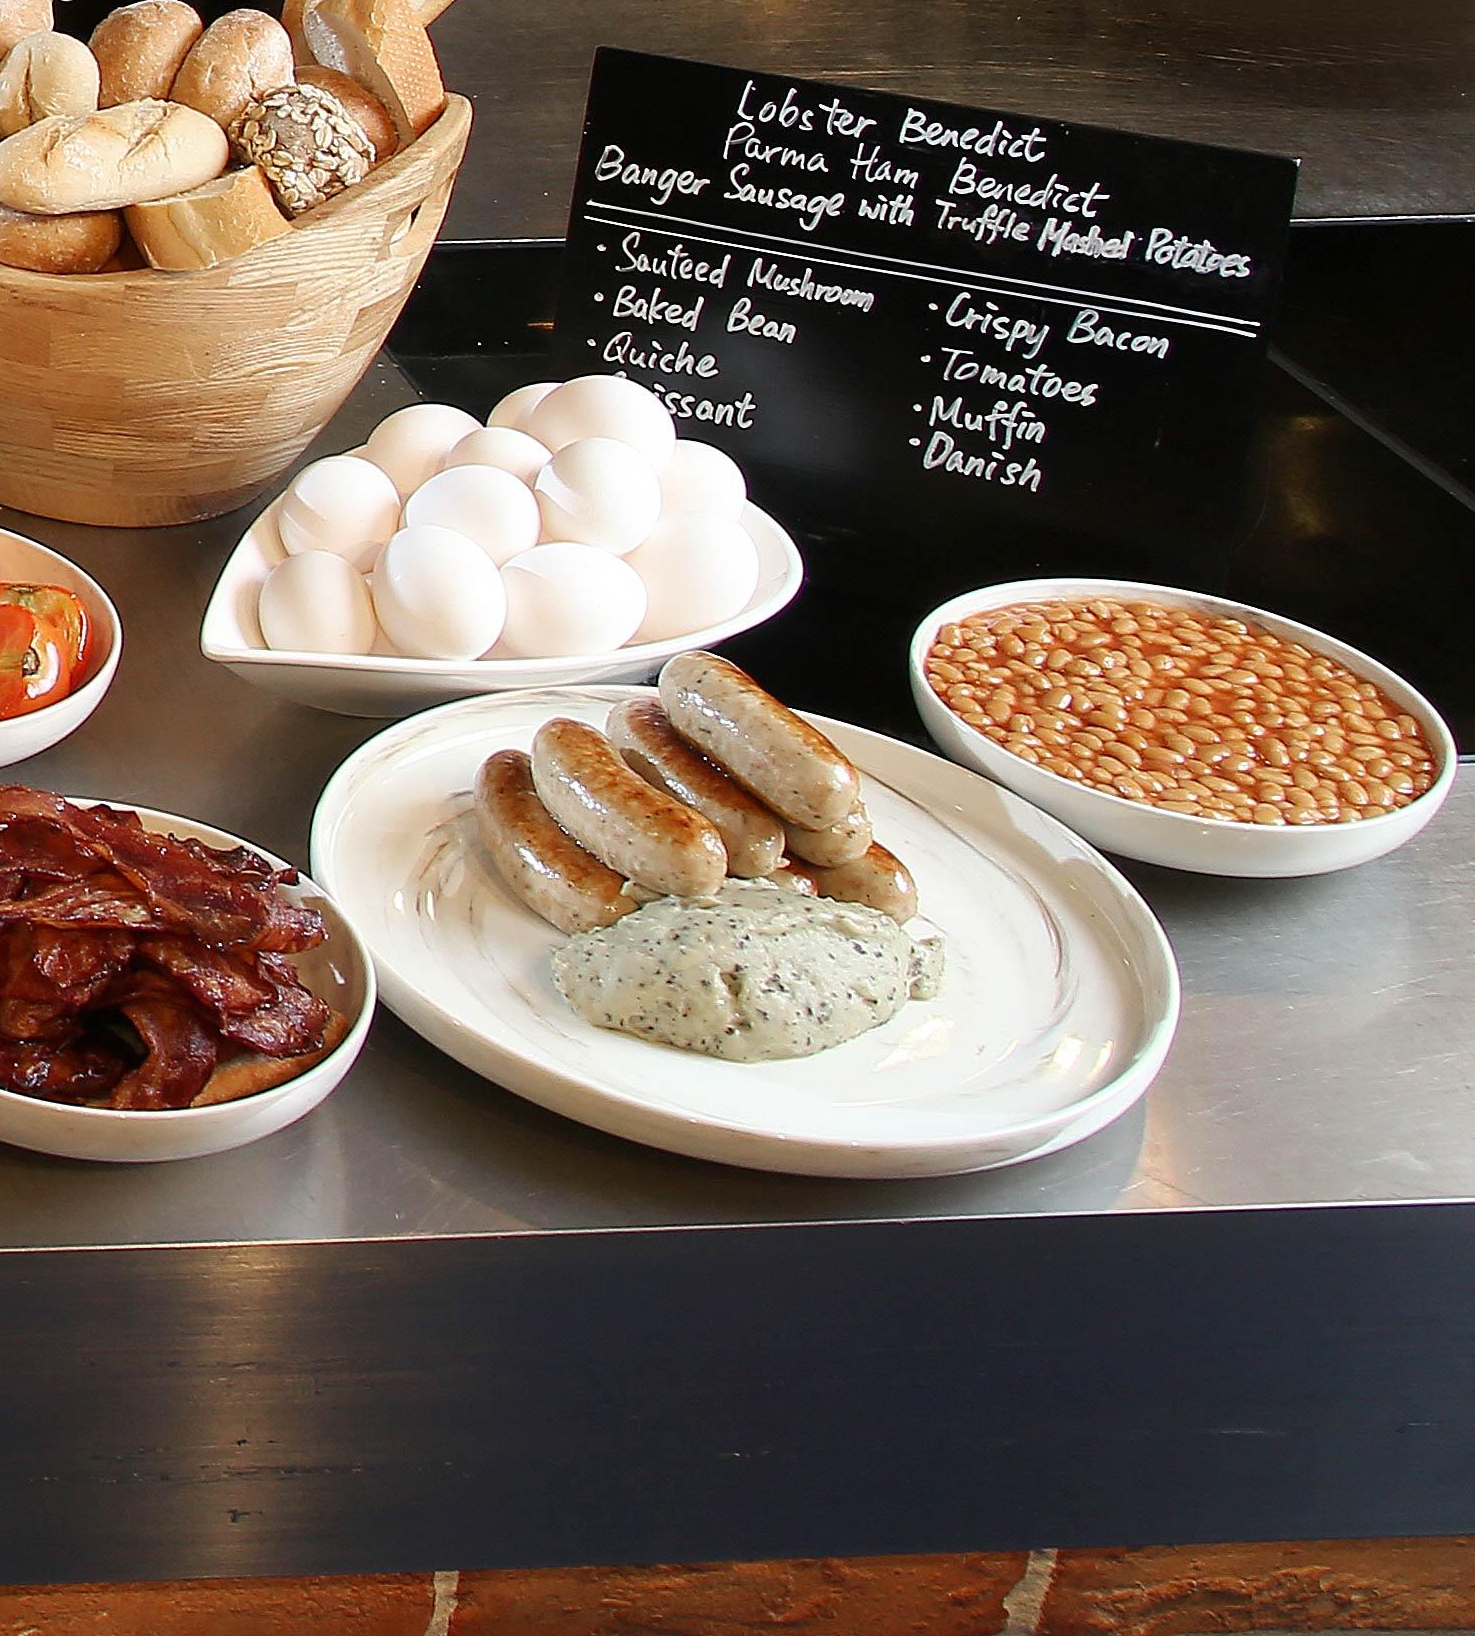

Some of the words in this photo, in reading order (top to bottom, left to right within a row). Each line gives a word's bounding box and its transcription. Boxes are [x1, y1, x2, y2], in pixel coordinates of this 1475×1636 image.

[737, 82, 876, 139] Lobster
[899, 108, 1047, 163] Benedict
[723, 122, 828, 174] Parma
[851, 148, 919, 189] Ham
[951, 160, 1109, 218] Benedict
[595, 145, 710, 206] Banger
[723, 165, 843, 232] Sausage
[859, 192, 913, 228] with
[936, 199, 1030, 246] Truffle
[1146, 228, 1252, 279] Potatoes
[615, 233, 729, 288] Sauteed
[747, 256, 876, 313] Mushroom
[613, 285, 704, 332] Baked
[727, 300, 797, 344] Bean
[946, 294, 1050, 354] Crispy
[1067, 309, 1169, 360] Bacon
[603, 333, 719, 380] Quiche
[941, 349, 1097, 406] Tomatoes
[930, 395, 1046, 446] Muffin
[923, 433, 1042, 493] Danish
